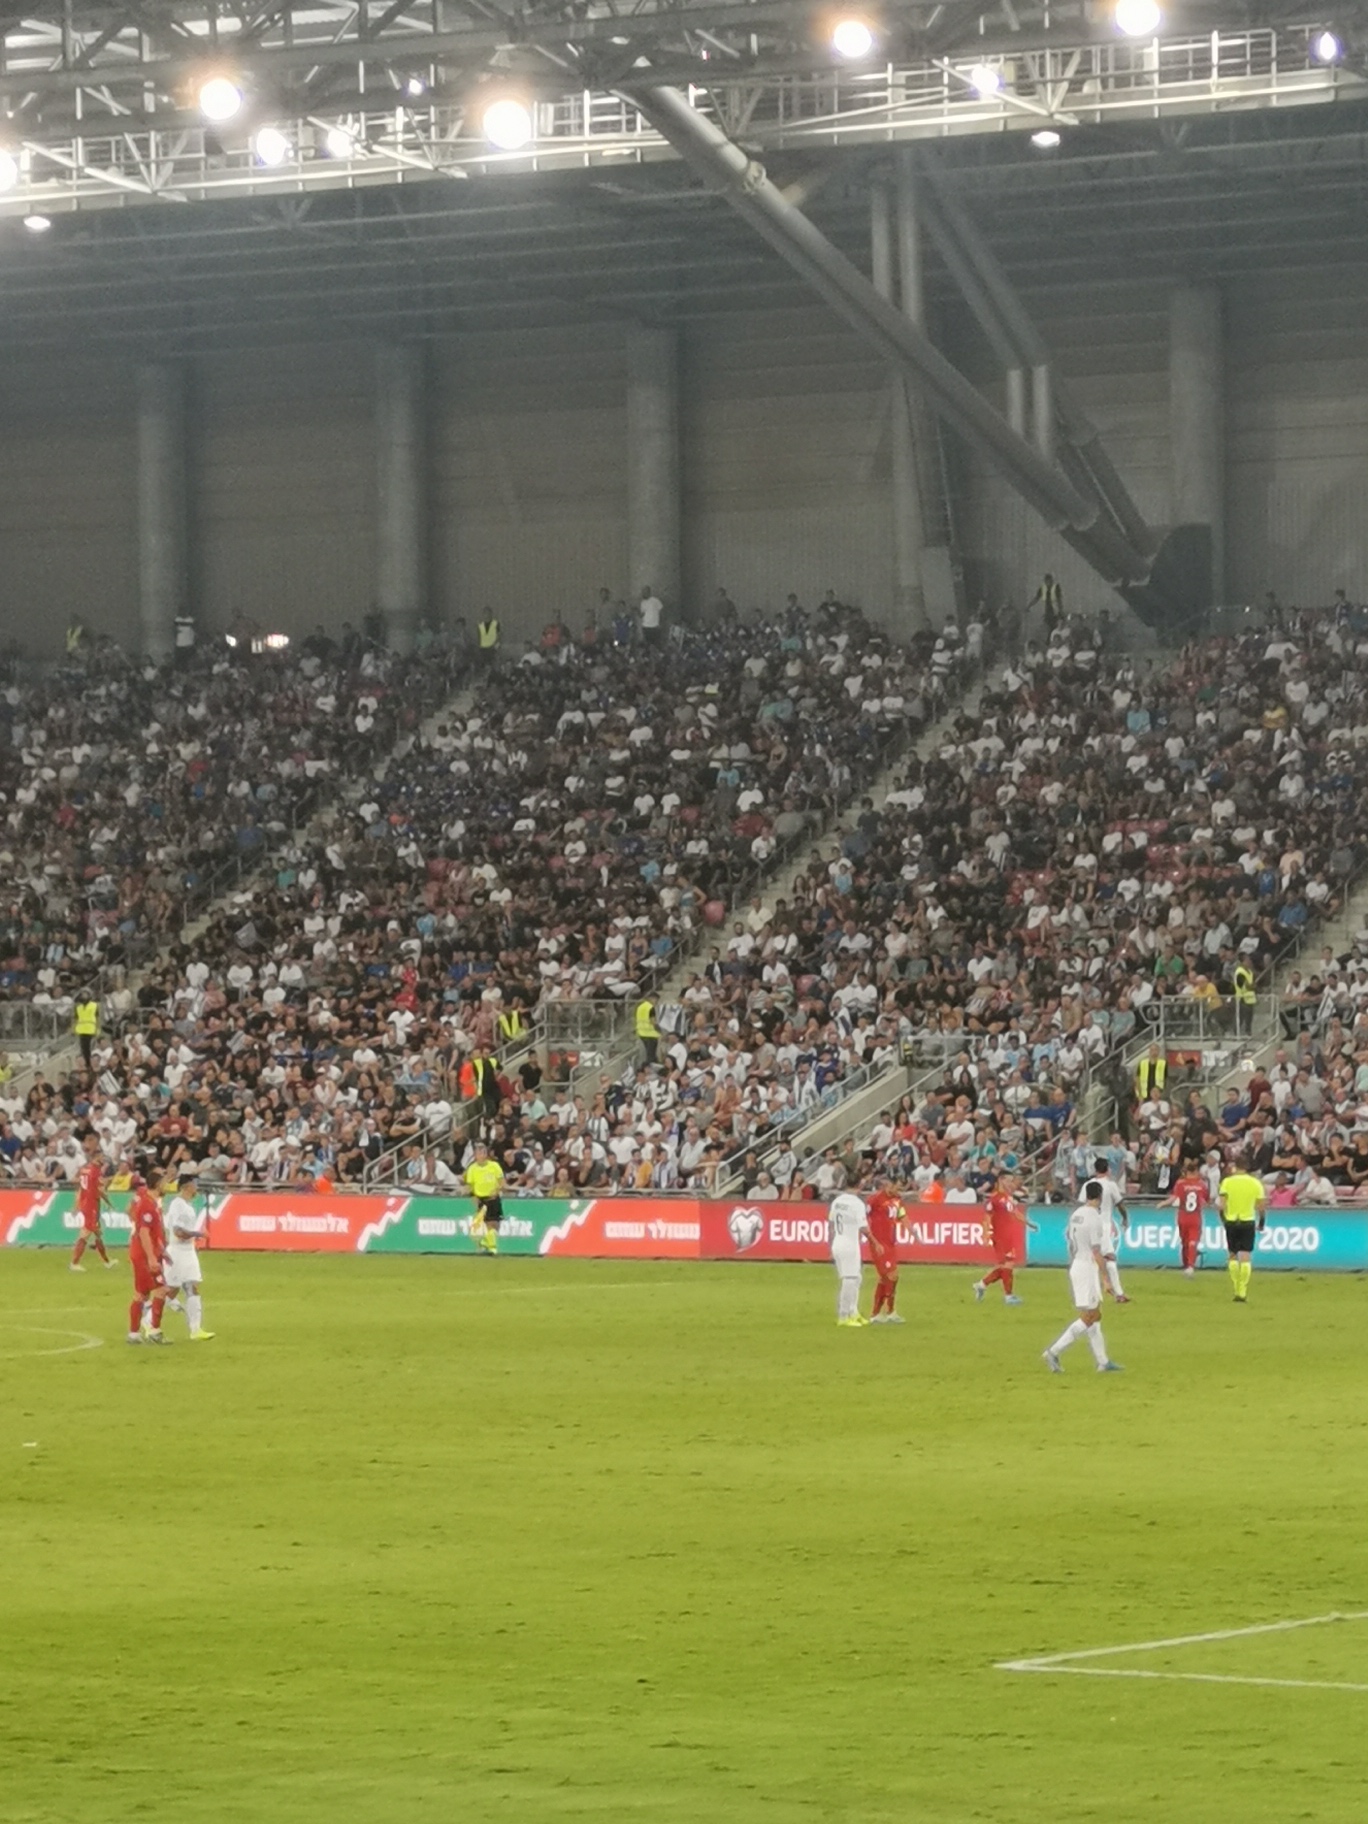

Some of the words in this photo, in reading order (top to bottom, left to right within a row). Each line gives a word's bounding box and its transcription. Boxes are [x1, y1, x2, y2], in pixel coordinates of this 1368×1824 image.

[1185, 1191, 1198, 1212] 8
[836, 1213, 844, 1236] 6
[895, 1222, 994, 1246] UALIFIER
[1258, 1226, 1320, 1251] 2020
